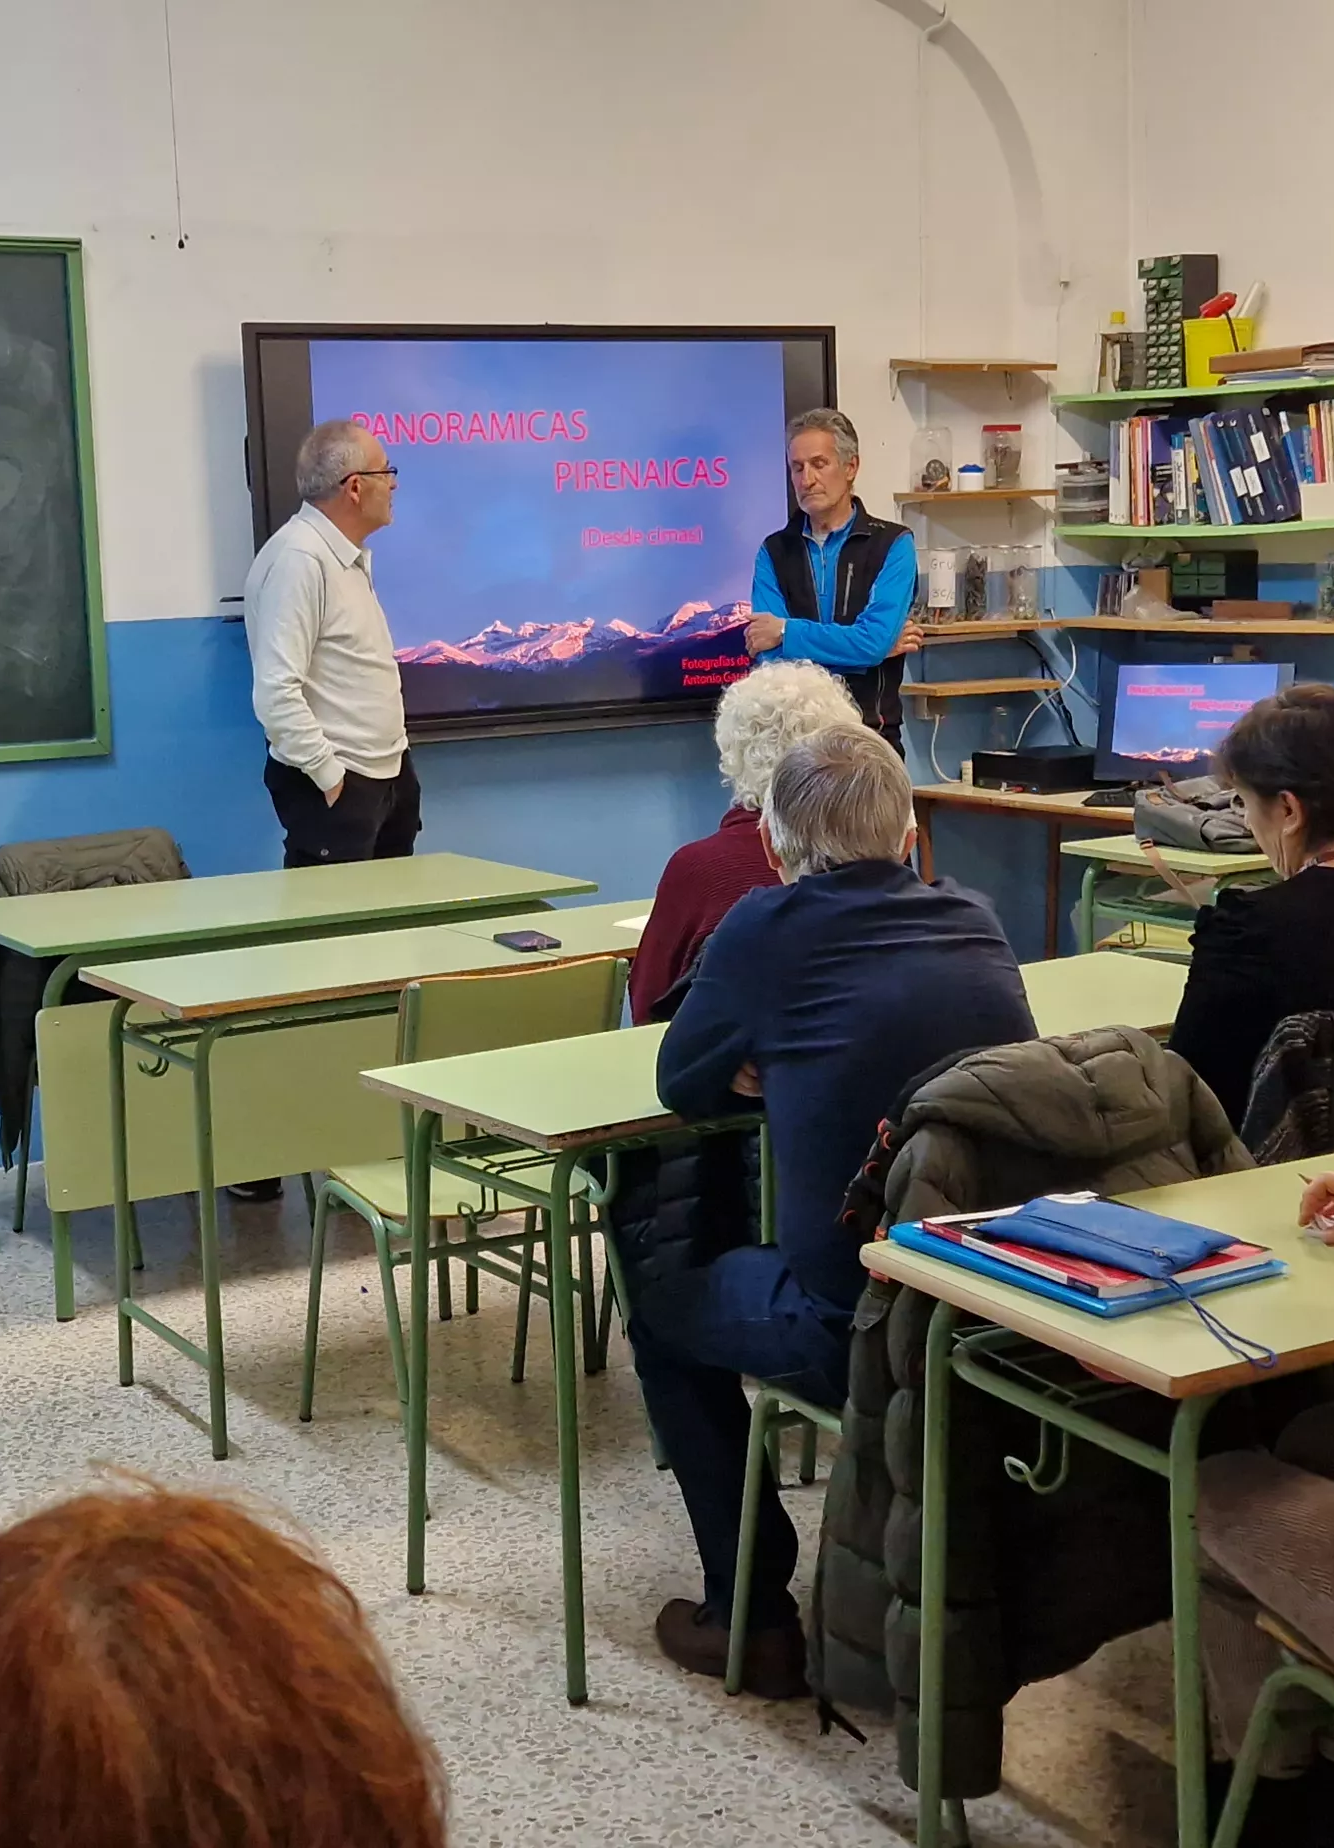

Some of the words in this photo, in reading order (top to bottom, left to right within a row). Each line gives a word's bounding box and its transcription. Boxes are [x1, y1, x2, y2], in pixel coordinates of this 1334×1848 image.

[351, 409, 588, 445] PANORAMICAS
[555, 457, 729, 492] PIRENAICAS
[582, 526, 642, 548] (Desde
[647, 524, 703, 546] cimas)
[737, 654, 750, 666] de
[683, 673, 722, 687] Antonio
